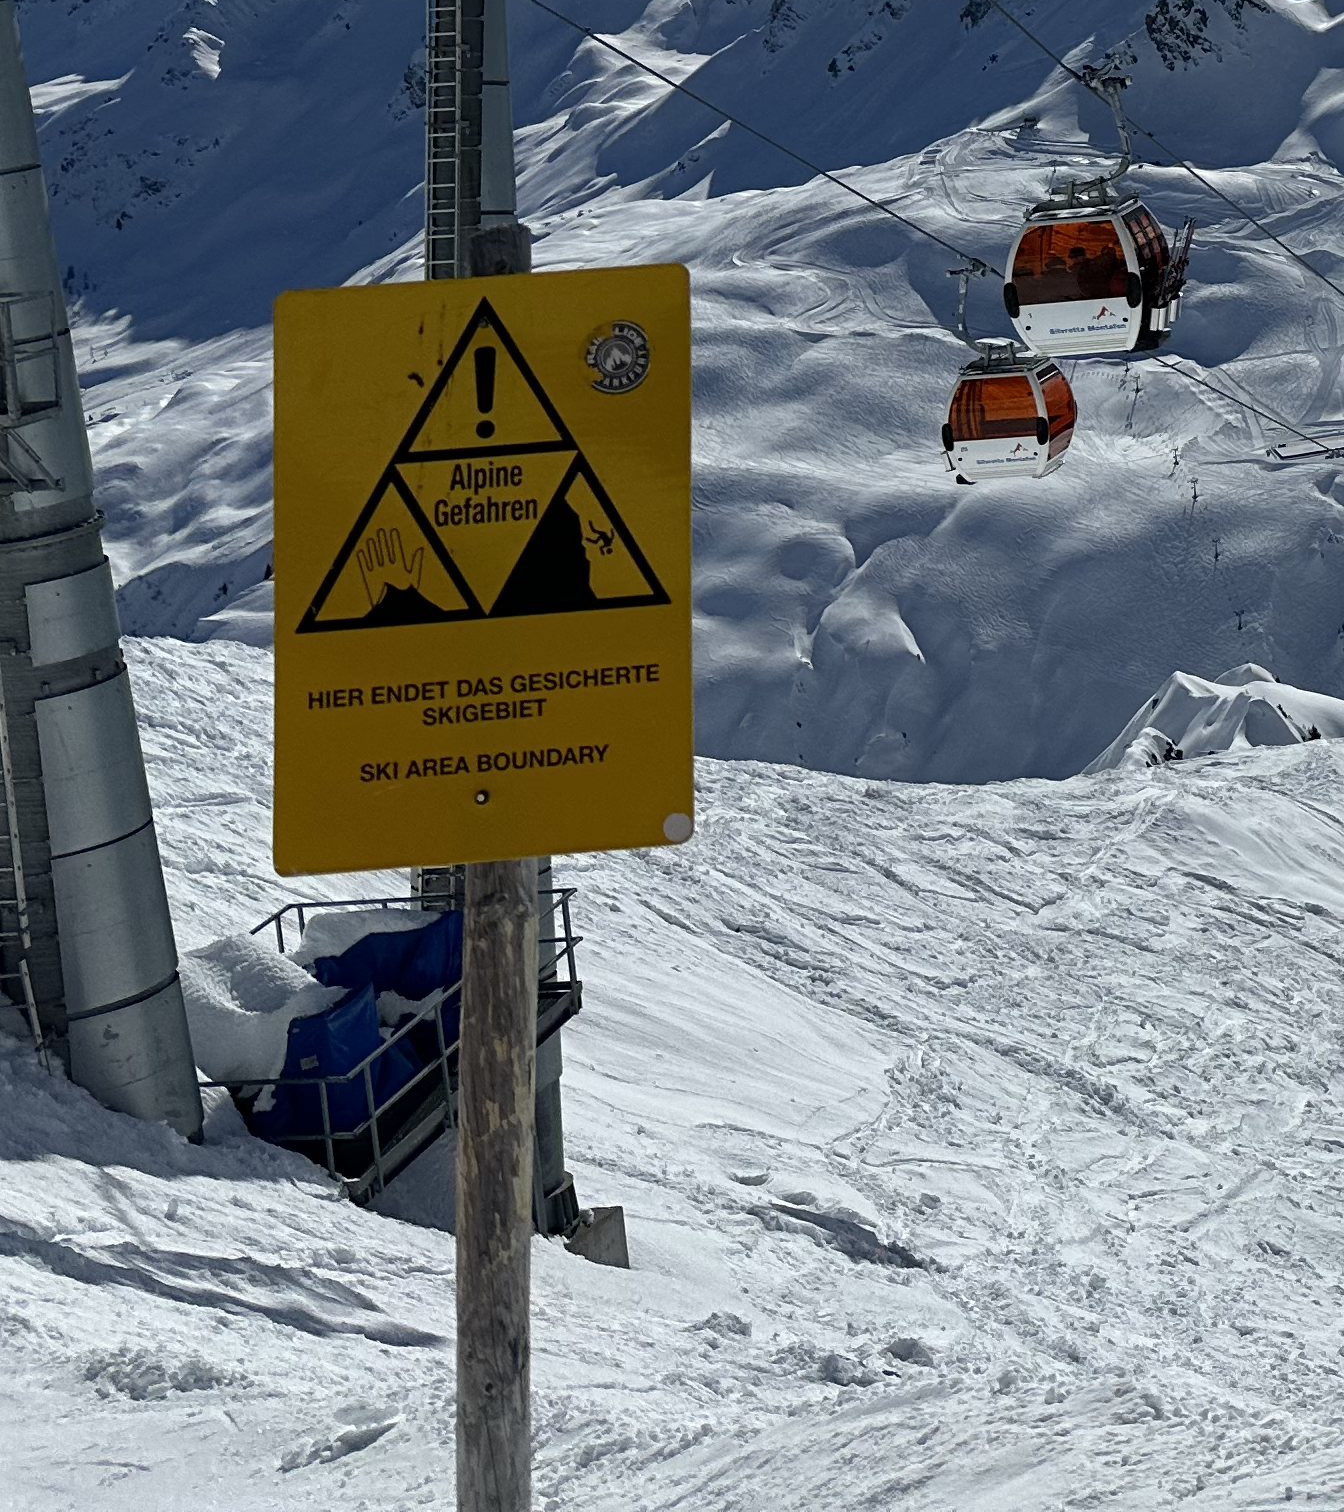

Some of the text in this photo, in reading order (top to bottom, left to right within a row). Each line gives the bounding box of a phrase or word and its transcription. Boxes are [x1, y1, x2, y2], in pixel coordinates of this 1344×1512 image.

[449, 460, 523, 496] Alpine
[434, 495, 538, 527] Gefahren
[307, 663, 661, 710] HIER ENDET DAS GESICHERTE
[421, 698, 547, 727] SKIGEBIET
[359, 743, 610, 783] SKI AREA BOUNDARY
